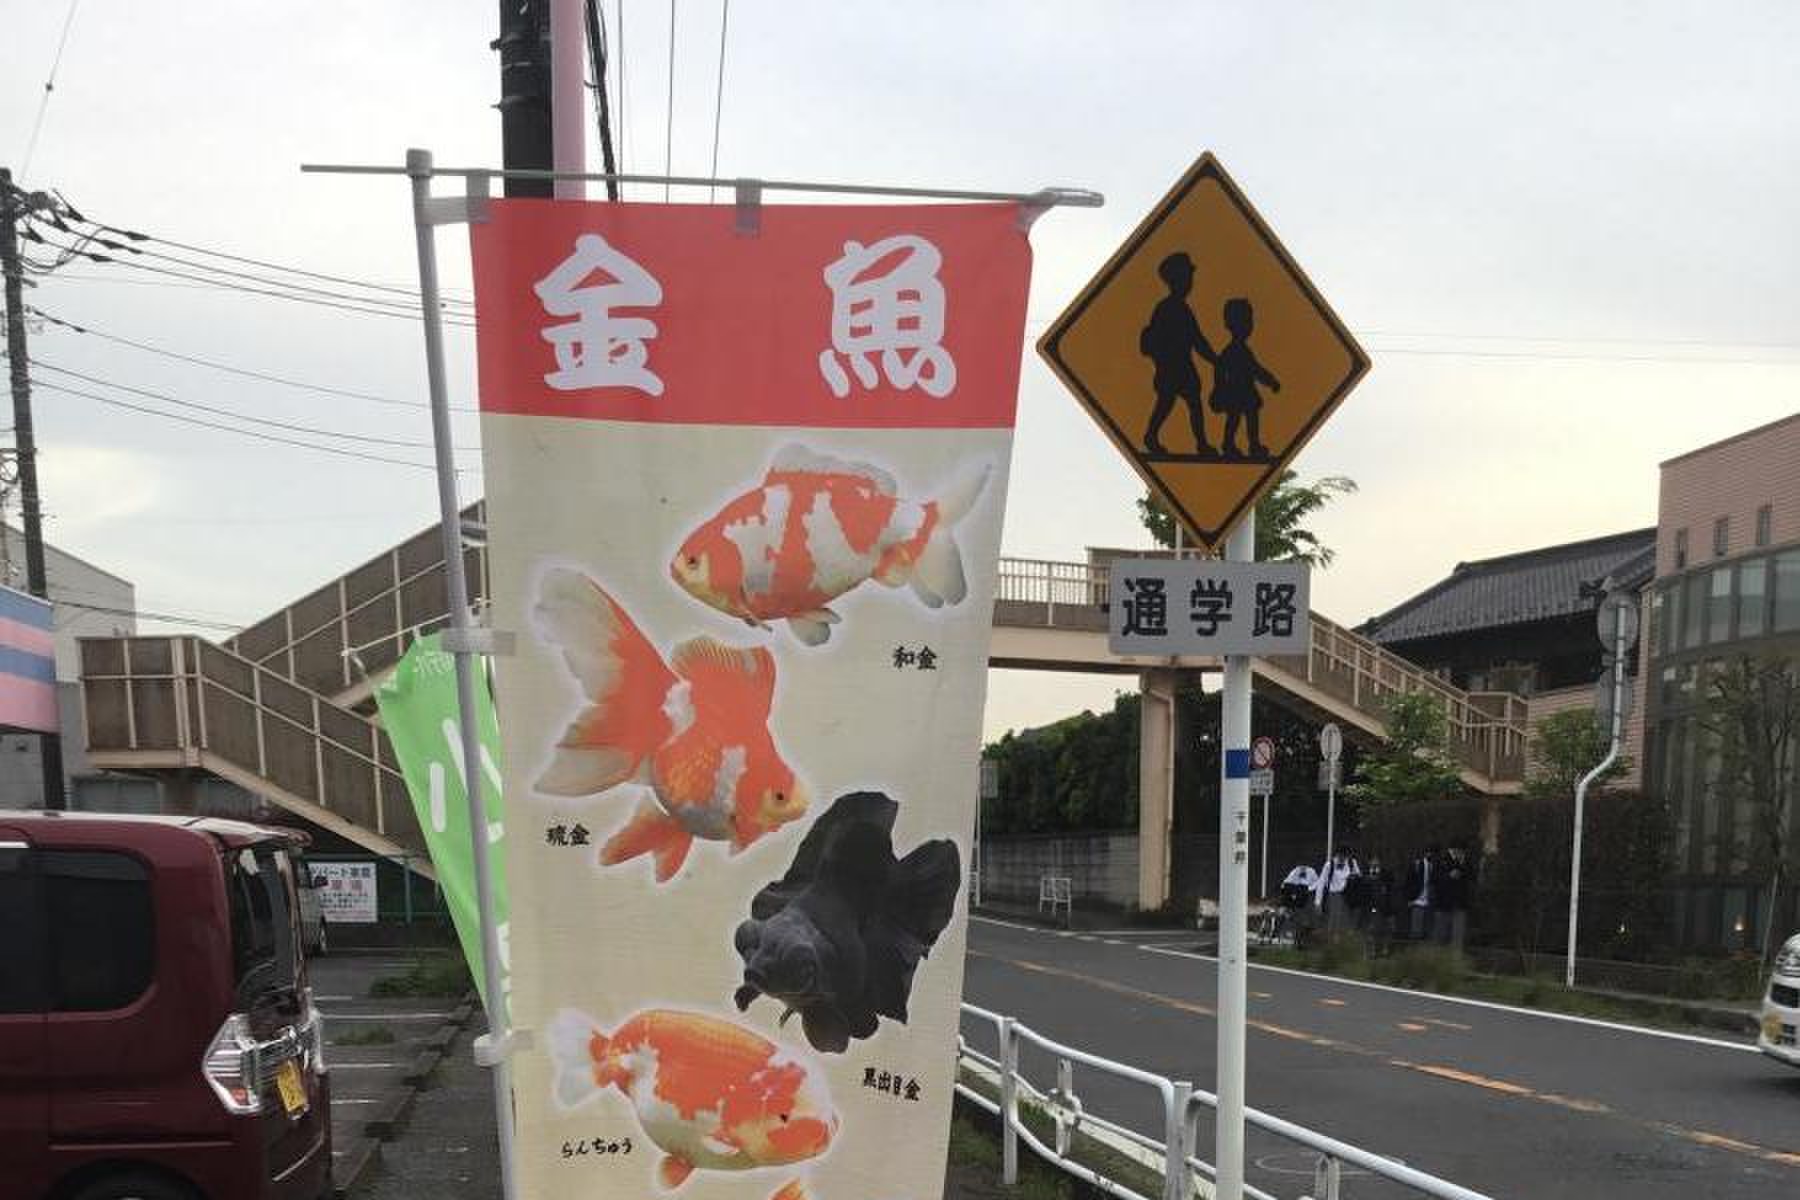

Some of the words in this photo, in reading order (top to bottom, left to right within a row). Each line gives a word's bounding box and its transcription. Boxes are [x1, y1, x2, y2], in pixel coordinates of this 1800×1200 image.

[534, 233, 957, 399] 金魚
[1122, 577, 1296, 637] 通学路
[893, 645, 936, 671] 和金
[863, 1067, 921, 1101] 黒出目金
[561, 1137, 632, 1159] らんちゅう
